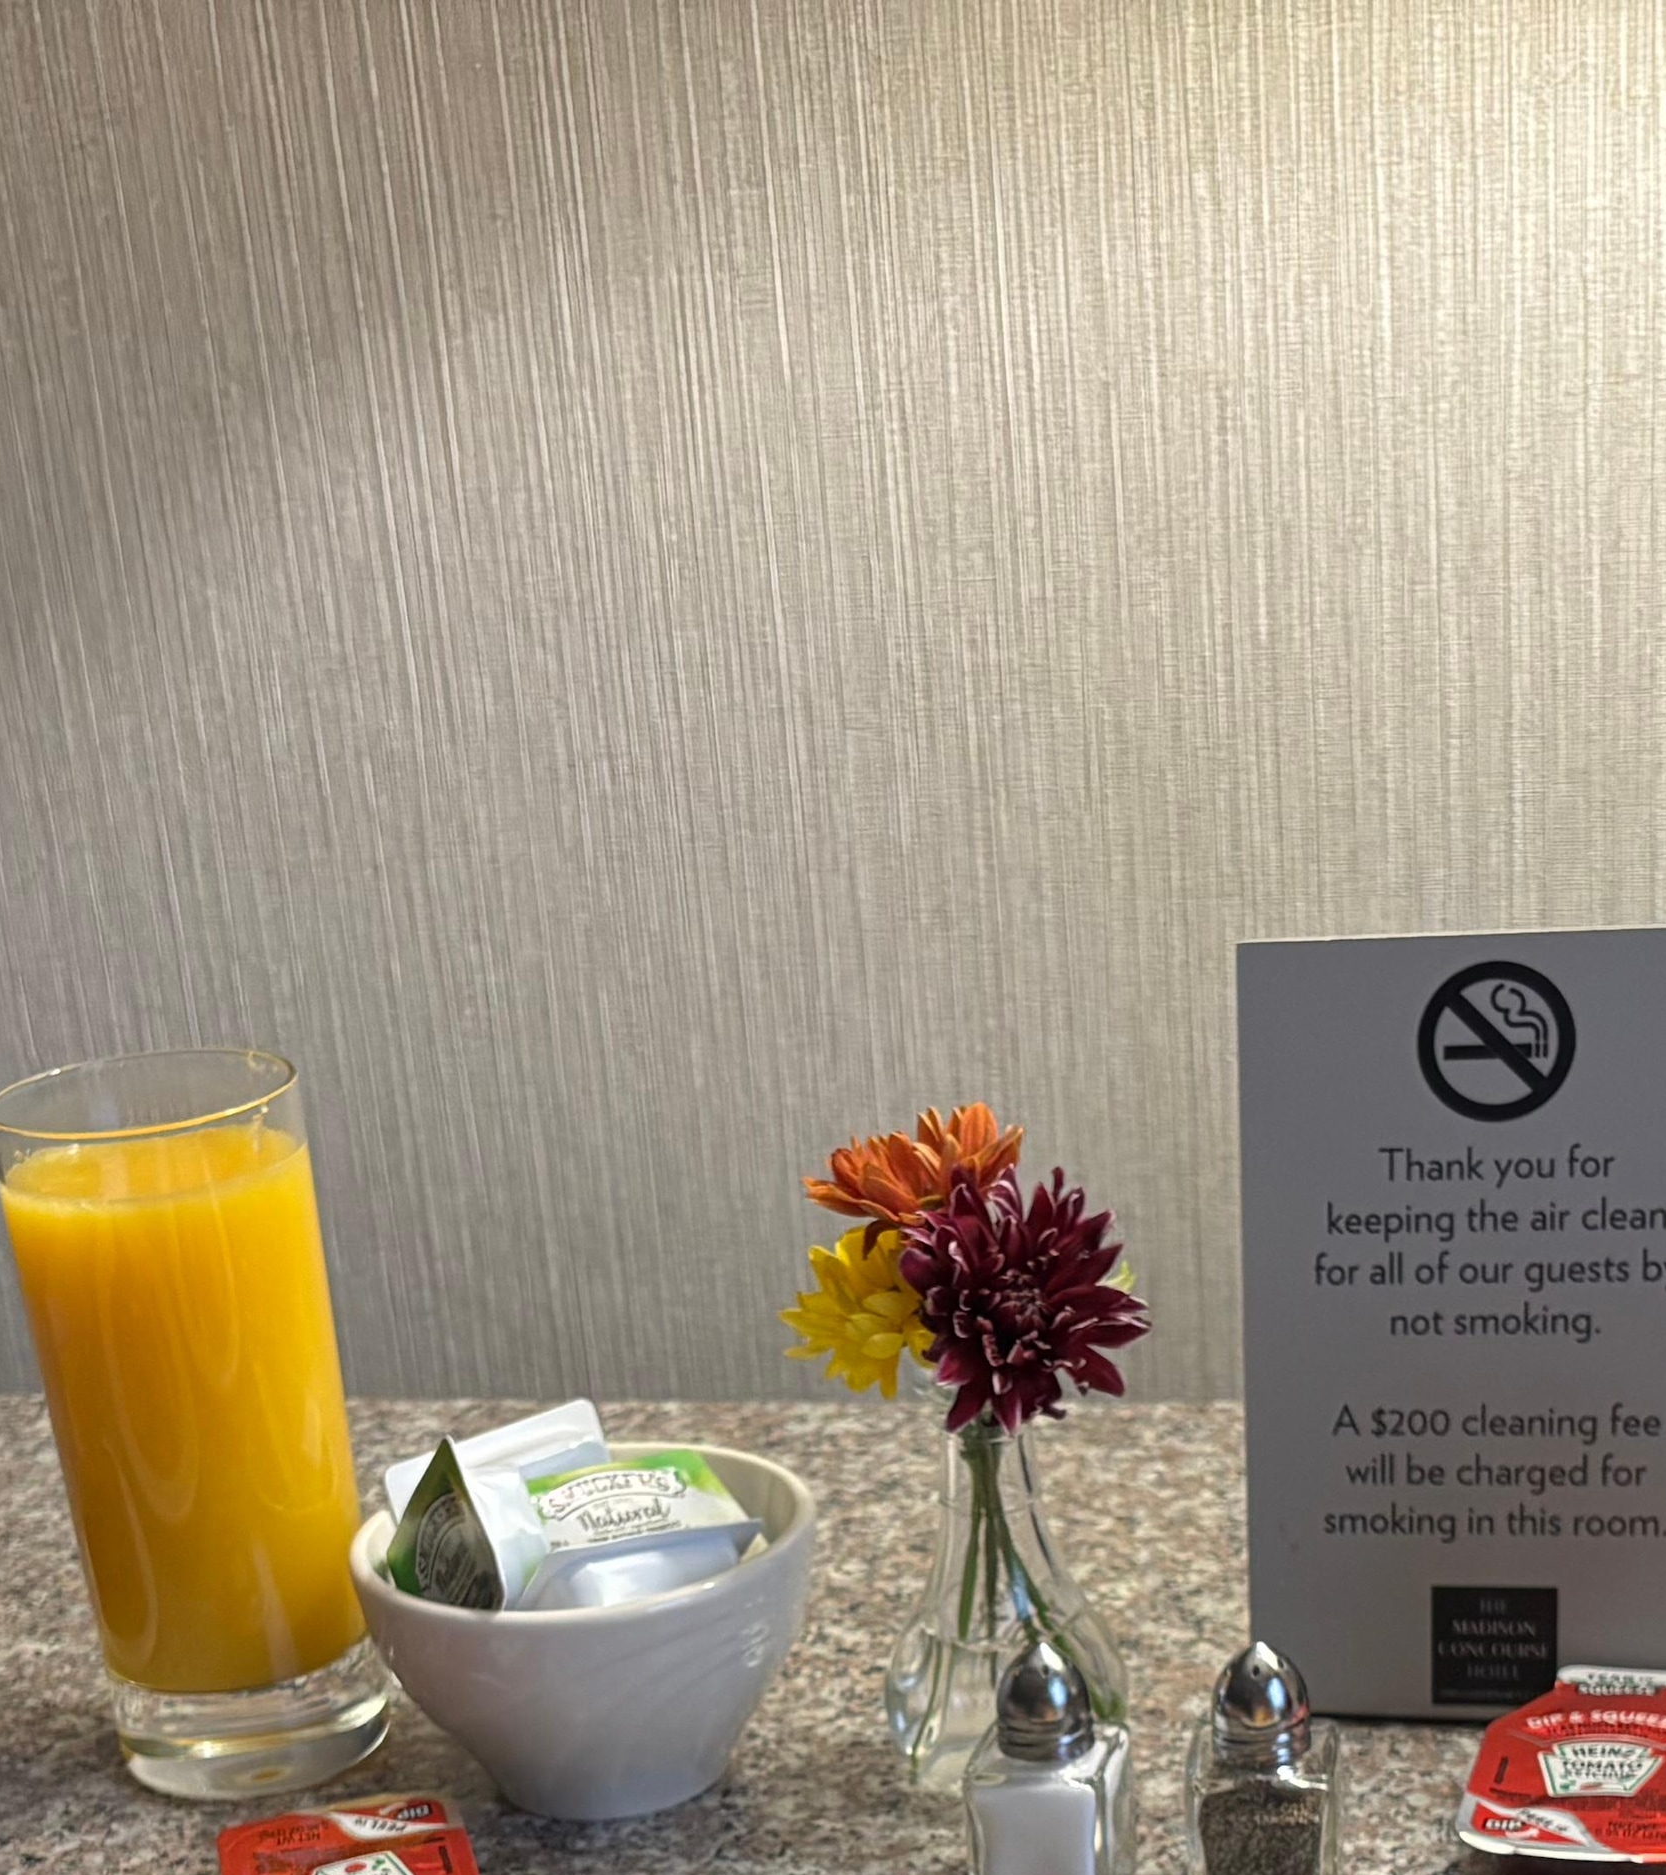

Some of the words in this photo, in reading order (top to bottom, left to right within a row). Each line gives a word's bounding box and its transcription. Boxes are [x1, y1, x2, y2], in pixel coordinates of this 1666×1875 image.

[1378, 1146, 1484, 1183] Thank
[1493, 1153, 1556, 1189] you
[1568, 1143, 1615, 1179] for
[1326, 1201, 1456, 1243] keeping
[1466, 1198, 1519, 1233] the
[1529, 1202, 1571, 1232] air
[1314, 1252, 1360, 1287] for
[1369, 1251, 1404, 1286] all
[1414, 1250, 1451, 1285] of
[1458, 1260, 1514, 1285] our
[1524, 1256, 1631, 1293] guests
[1389, 1310, 1445, 1337] not
[1453, 1301, 1602, 1344] smoking.
[1331, 1404, 1362, 1438] A
[1370, 1405, 1452, 1440] $200
[1461, 1403, 1599, 1446] cleaning
[1610, 1403, 1663, 1437] fee
[1345, 1453, 1396, 1487] will
[1405, 1453, 1447, 1487] be
[1456, 1453, 1589, 1496] charged
[1600, 1453, 1649, 1488] for
[576, 1496, 671, 1532] Natural
[1323, 1503, 1457, 1544] smoking
[1467, 1507, 1495, 1537] in
[1506, 1503, 1562, 1537] this
[1451, 1618, 1537, 1637] MADISON
[1436, 1641, 1550, 1660] CONCOURSE
[1526, 1711, 1564, 1729] DIP
[1569, 1709, 1585, 1724] &
[1562, 1759, 1644, 1772] TOMATO
[1572, 1745, 1638, 1759] HEINZ
[397, 1804, 430, 1820] DIP
[1485, 1818, 1523, 1831] DIP
[370, 1820, 407, 1833] PEEL
